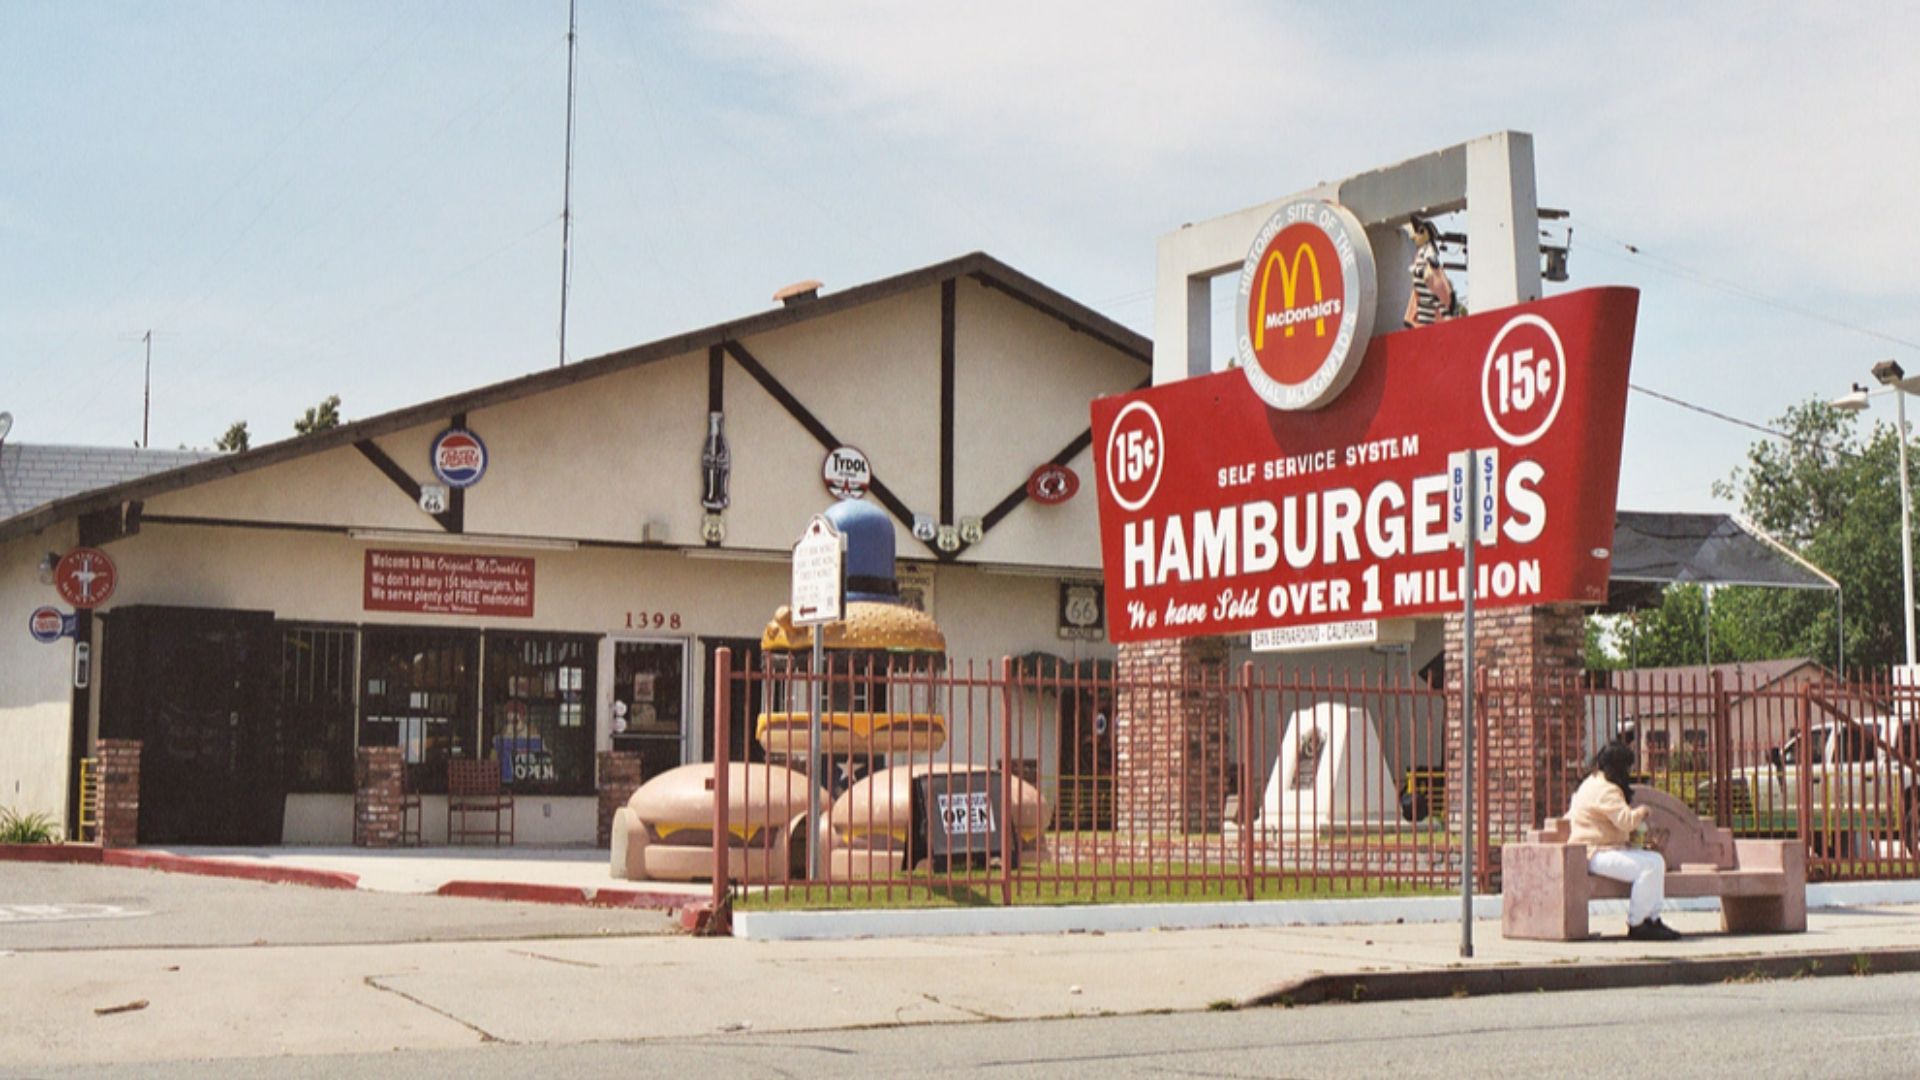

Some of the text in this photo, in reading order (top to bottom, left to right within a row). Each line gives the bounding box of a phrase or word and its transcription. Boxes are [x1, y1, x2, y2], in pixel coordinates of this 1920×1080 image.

[1240, 203, 1355, 295] HISTORIC SITE OF THE
[1265, 298, 1341, 330] McDonald's
[1239, 334, 1280, 401] ORIGINAL
[1495, 347, 1552, 415] 15¢
[1115, 429, 1155, 484] 15¢
[1217, 434, 1419, 488] SELF SERVICE SYSTEM
[424, 495, 441, 512] 66
[1453, 466, 1464, 523] BUS
[1483, 455, 1495, 532] STOP
[707, 523, 721, 539] 66
[917, 523, 931, 539] 66
[965, 524, 979, 541] 66
[1124, 459, 1547, 590] HAMBURGES
[942, 533, 956, 548] 66
[371, 553, 527, 575] Welcome to the Original McDonald's
[371, 572, 385, 586] We
[387, 573, 409, 587] don't
[411, 574, 425, 587] sell
[427, 577, 442, 590] any
[461, 578, 514, 594] Hamburgers,
[515, 580, 529, 593] but
[1127, 558, 1542, 631] We have Sold OVER 1 MILLION
[371, 586, 528, 607] We serve plenty of FREE memories!
[625, 611, 681, 630] 1398
[1072, 600, 1094, 620] 66
[1255, 630, 1269, 648] SAN
[1271, 624, 1321, 646] BERNARDINO
[1327, 620, 1374, 641] CALIFORNIA
[943, 808, 990, 824] OPEN
